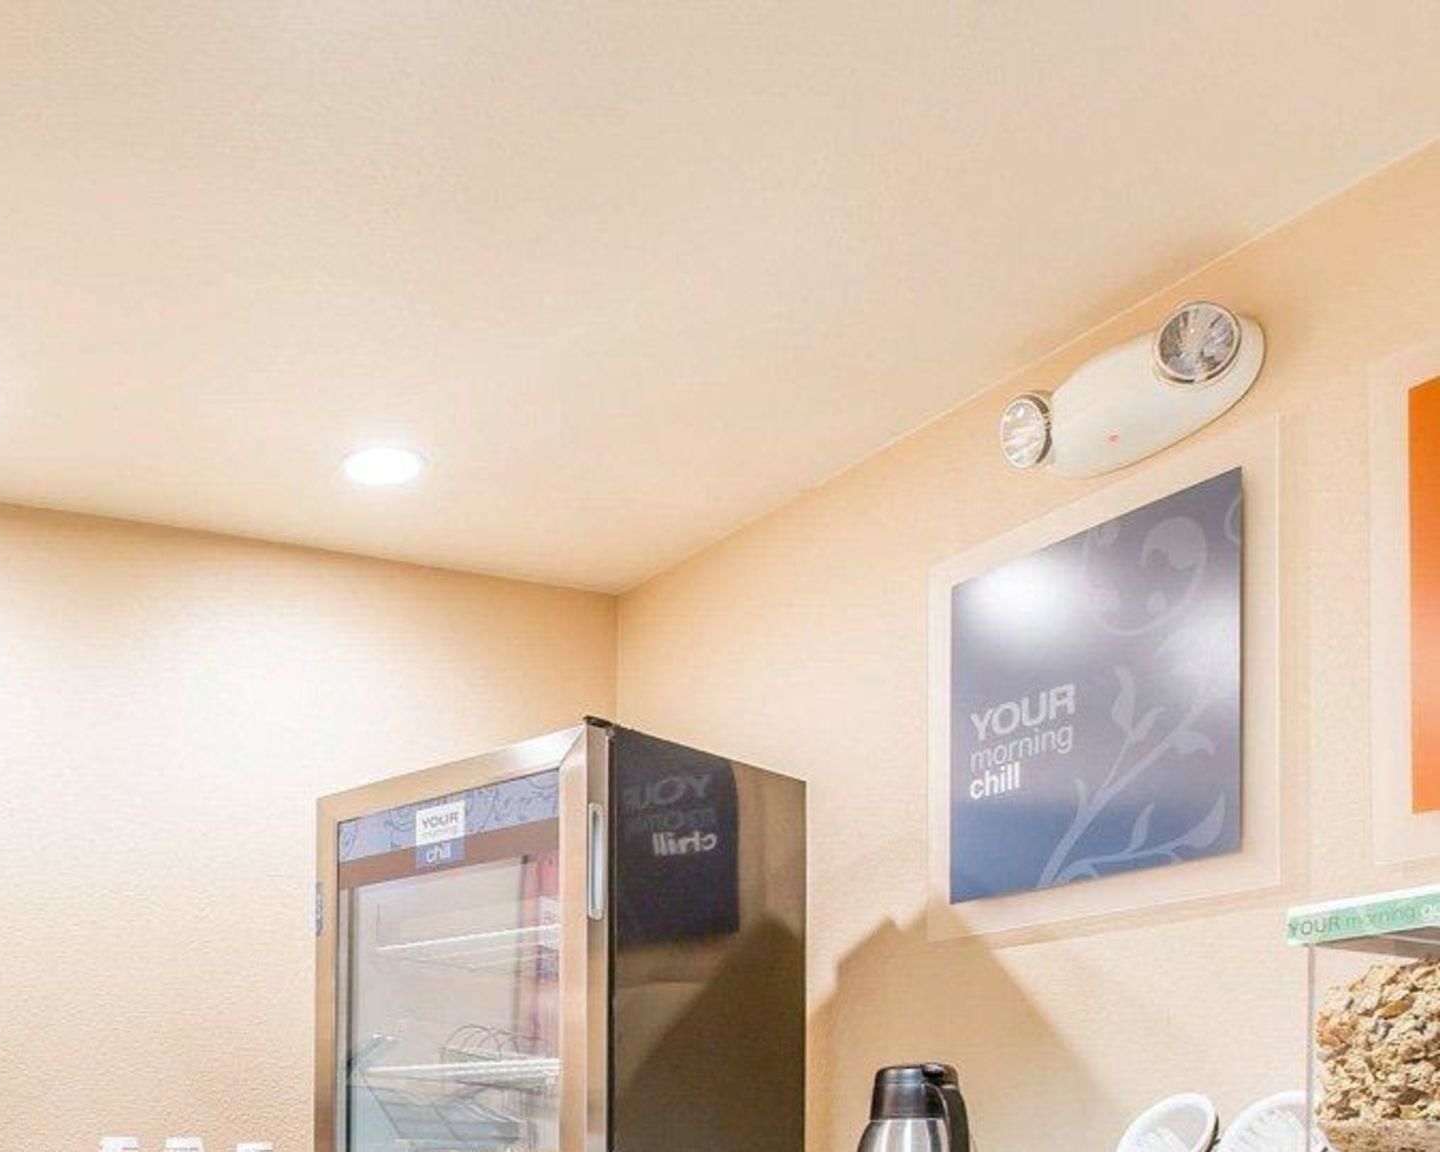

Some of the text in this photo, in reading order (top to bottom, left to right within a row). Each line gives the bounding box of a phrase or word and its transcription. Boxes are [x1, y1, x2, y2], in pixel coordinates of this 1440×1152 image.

[969, 684, 1075, 741] YOUR
[970, 724, 1073, 772] morning
[969, 761, 1021, 799] chill
[421, 812, 459, 829] YOUR
[1287, 915, 1341, 938] YOUR
